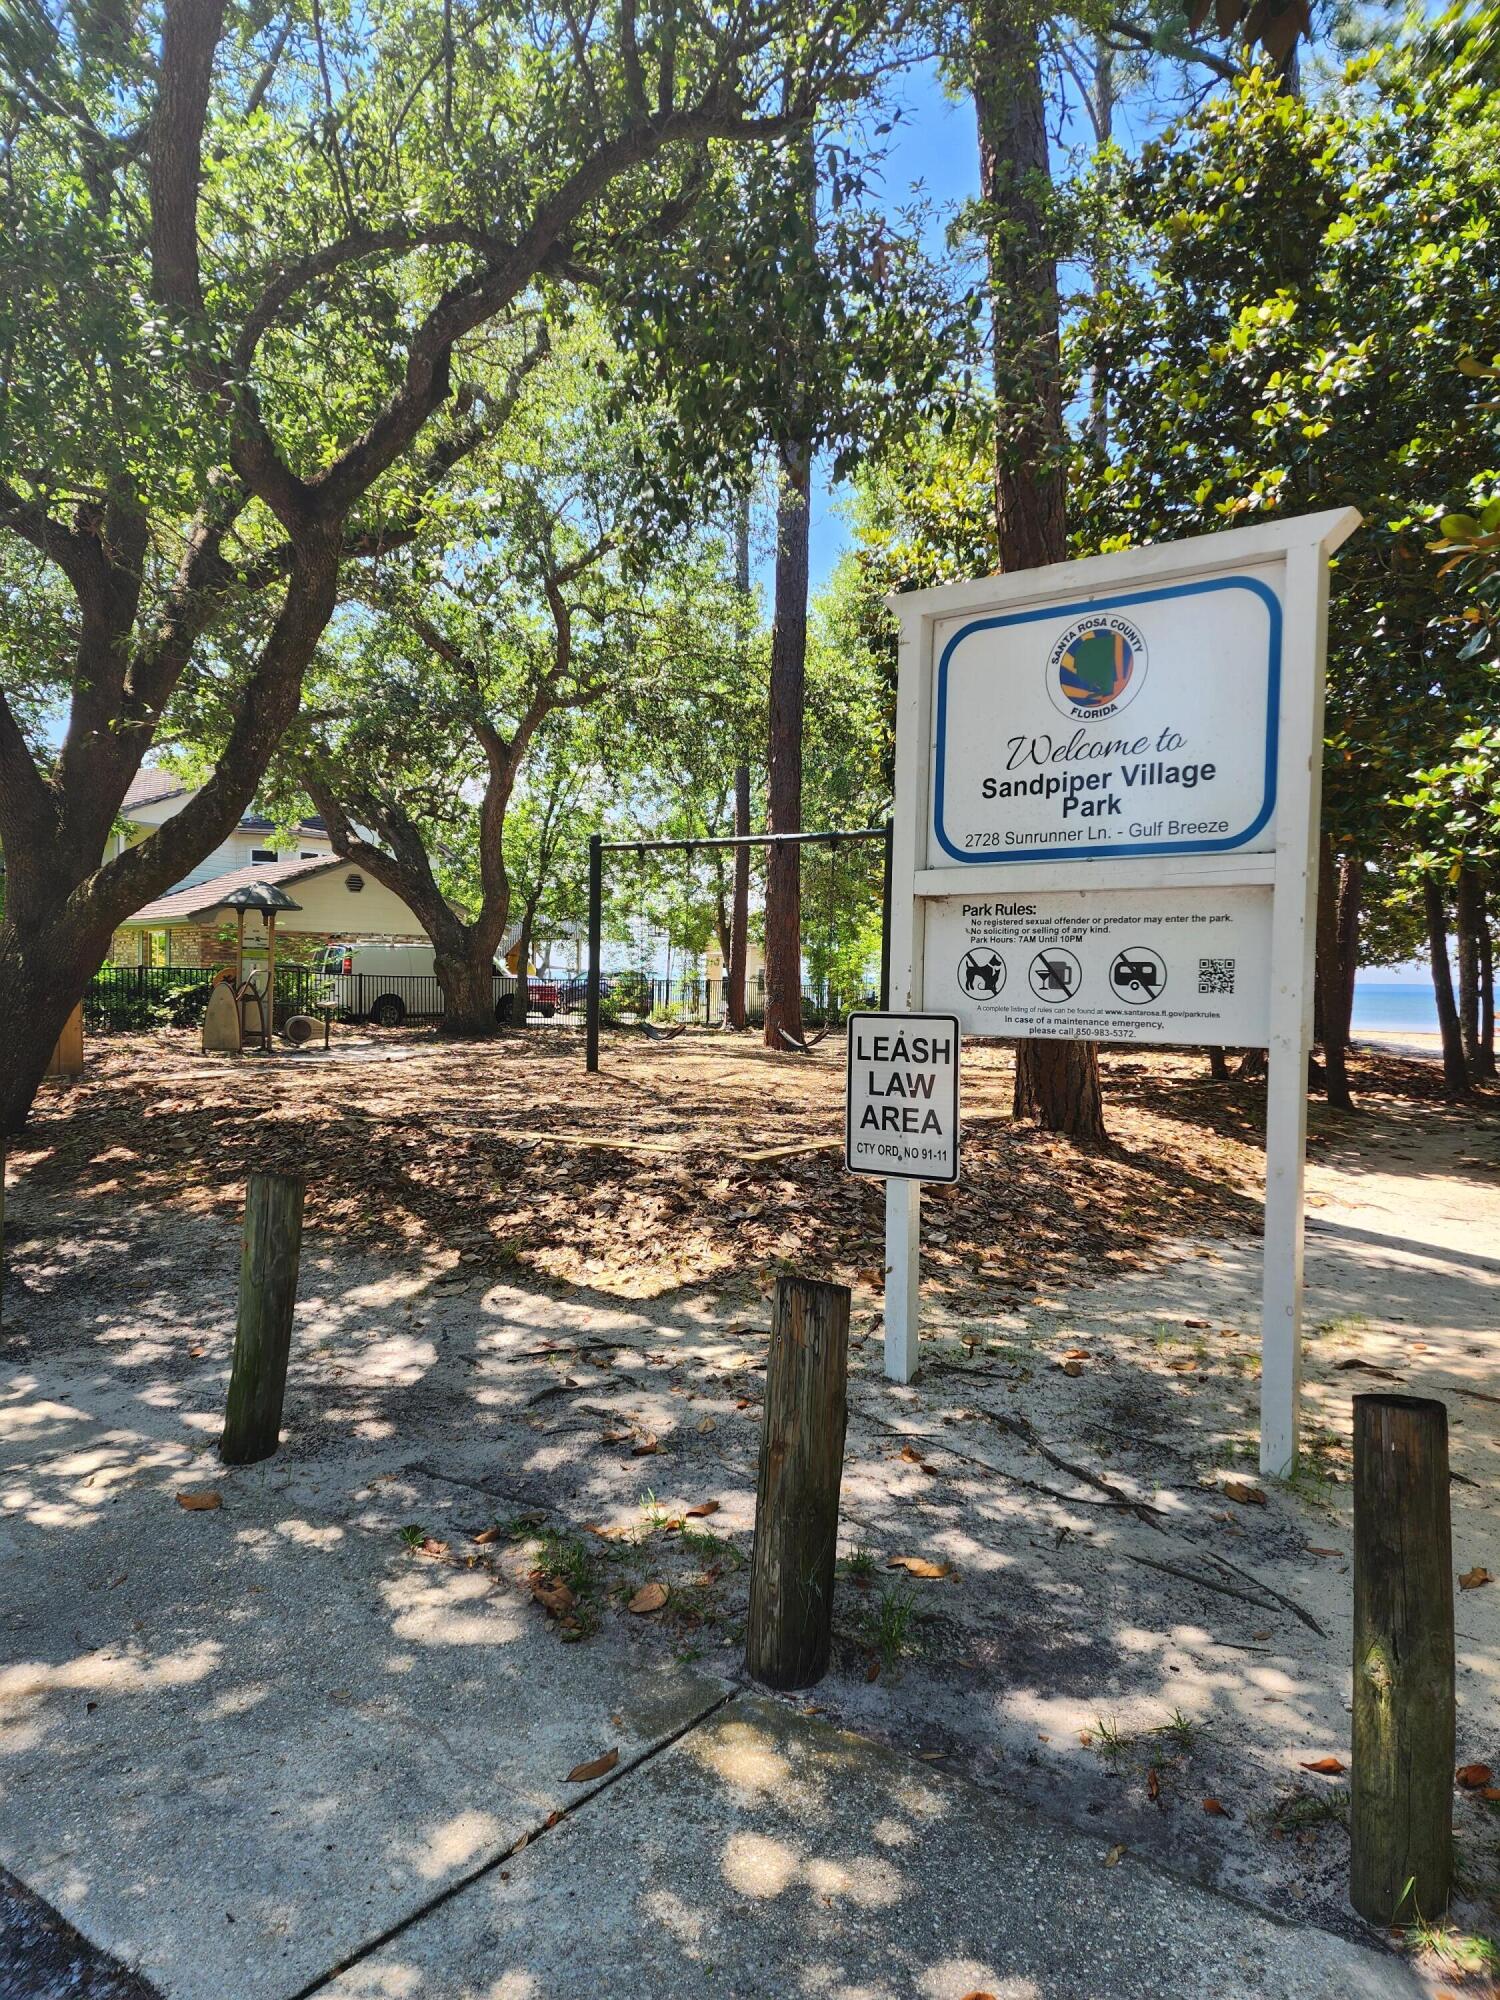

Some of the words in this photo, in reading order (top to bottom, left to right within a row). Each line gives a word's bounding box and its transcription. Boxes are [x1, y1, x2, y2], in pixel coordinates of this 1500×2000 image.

[1052, 632, 1076, 664] SANTA
[1078, 618, 1107, 633] ROSA
[1110, 620, 1143, 653] COUNTY
[1070, 703, 1118, 719] FLORIDA
[1006, 728, 1150, 770] Welcome
[1156, 726, 1188, 752] to
[982, 771, 1112, 800] Sandpiper
[1121, 762, 1216, 788] Village
[1062, 794, 1122, 818] Park
[965, 832, 1000, 848] 2728
[1004, 829, 1083, 845] Sunrunner
[1088, 826, 1111, 840] Ln.
[1129, 821, 1164, 838] Gulf
[1168, 820, 1229, 835] Breeze
[962, 904, 992, 916] Park
[995, 902, 1036, 916] Rules:
[984, 918, 1024, 927] registered
[1026, 917, 1052, 925] sexual
[1054, 916, 1090, 924] offender
[1104, 916, 1141, 926] predator
[1144, 916, 1162, 924] may
[1191, 914, 1206, 922] the
[1209, 914, 1233, 924] park.
[984, 926, 1020, 936] soliciting
[1032, 926, 1060, 936] selling
[1062, 926, 1070, 934] of
[1072, 927, 1088, 936] any
[1090, 926, 1111, 934] kind.
[990, 936, 1016, 944] Hours:
[1018, 935, 1037, 943] 7AM
[1038, 935, 1058, 943] Until
[1060, 934, 1083, 942] 10PM
[983, 1005, 1010, 1014] complete
[1010, 1006, 1028, 1015] listing
[1077, 1007, 1096, 1015] found
[1030, 1027, 1057, 1036] please
[1058, 1028, 1075, 1036] call
[1054, 1018, 1110, 1027] maintenance
[857, 1036, 950, 1065] LEASH
[868, 1071, 936, 1100] LAW
[860, 1104, 943, 1136] AREA
[856, 1142, 876, 1154] CTY
[904, 1147, 919, 1159] NO
[922, 1148, 947, 1162] 91-11
